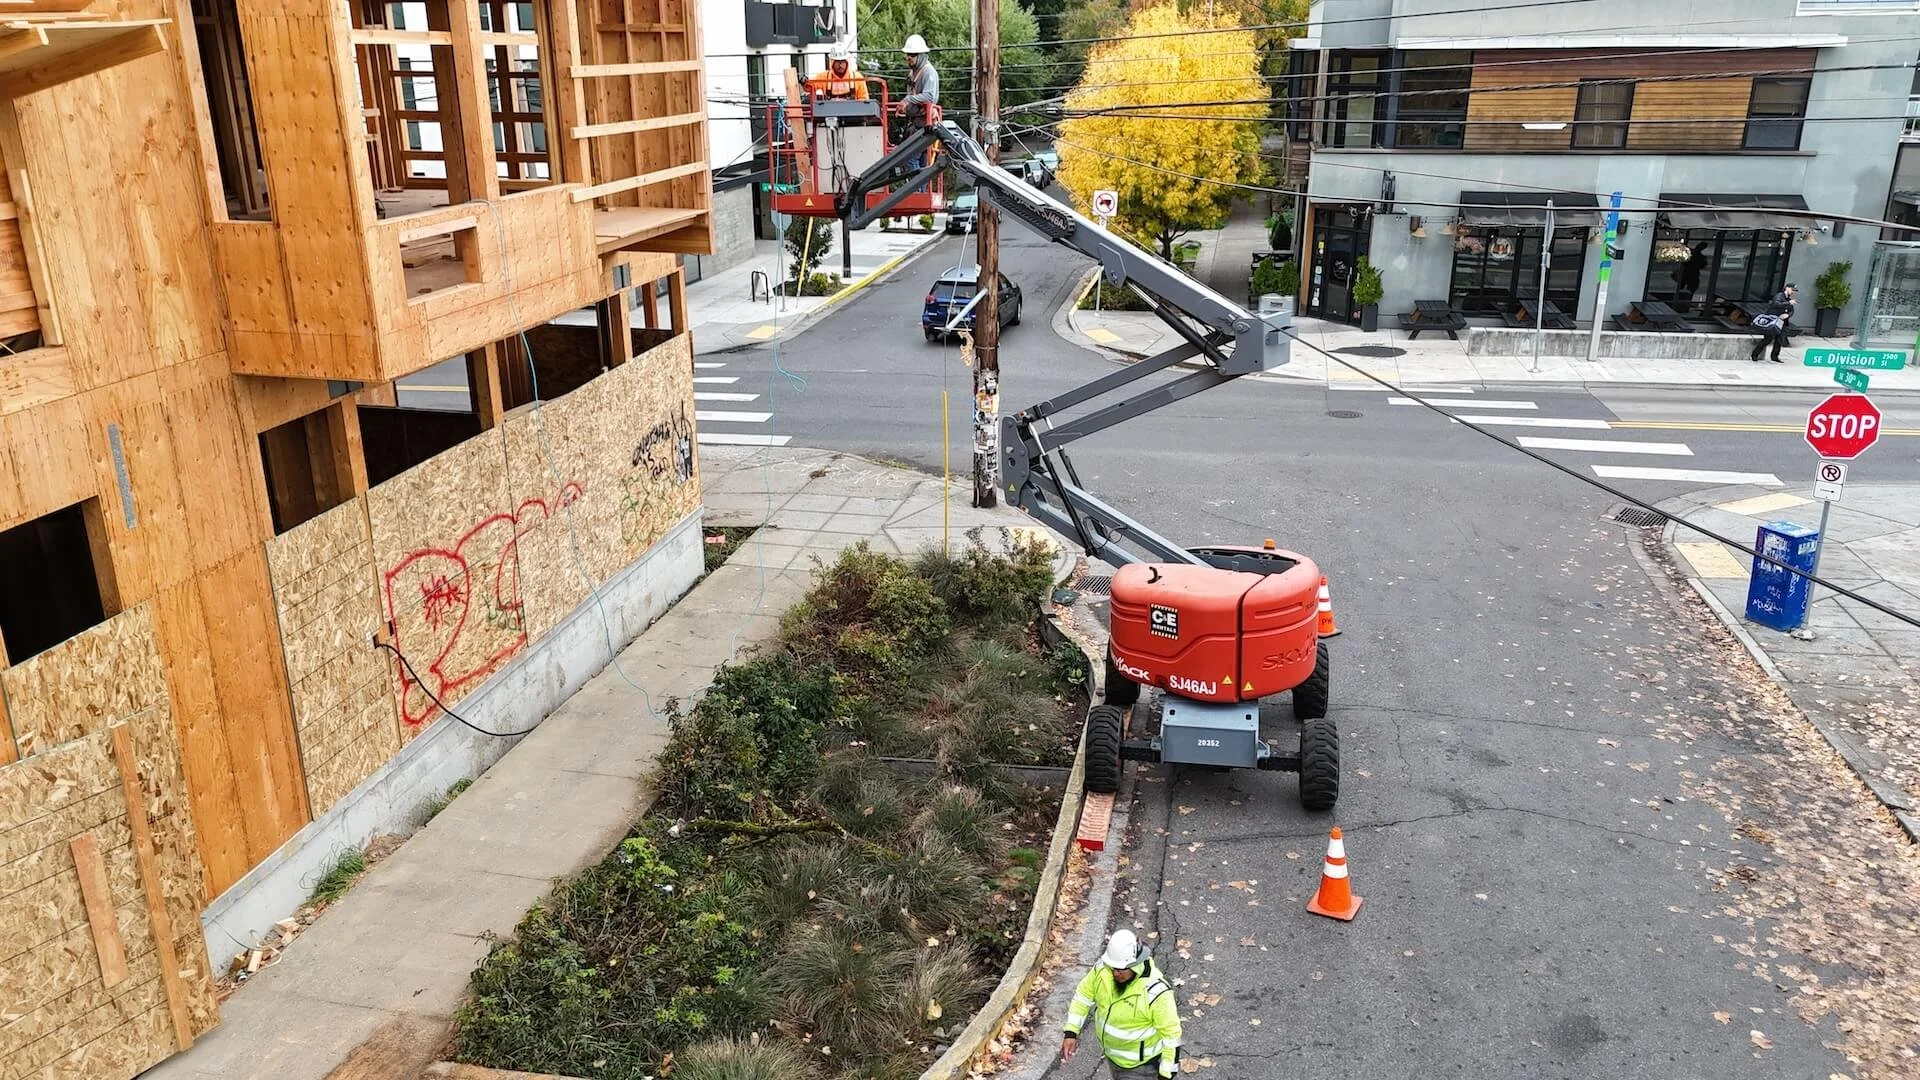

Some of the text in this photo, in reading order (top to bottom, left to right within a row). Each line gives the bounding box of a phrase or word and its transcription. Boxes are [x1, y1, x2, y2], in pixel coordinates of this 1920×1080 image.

[1813, 352, 1876, 366] SE Division
[1810, 413, 1877, 439] STOP
[1151, 622, 1177, 634] RENTALS
[1169, 674, 1217, 695] SJ46AJ
